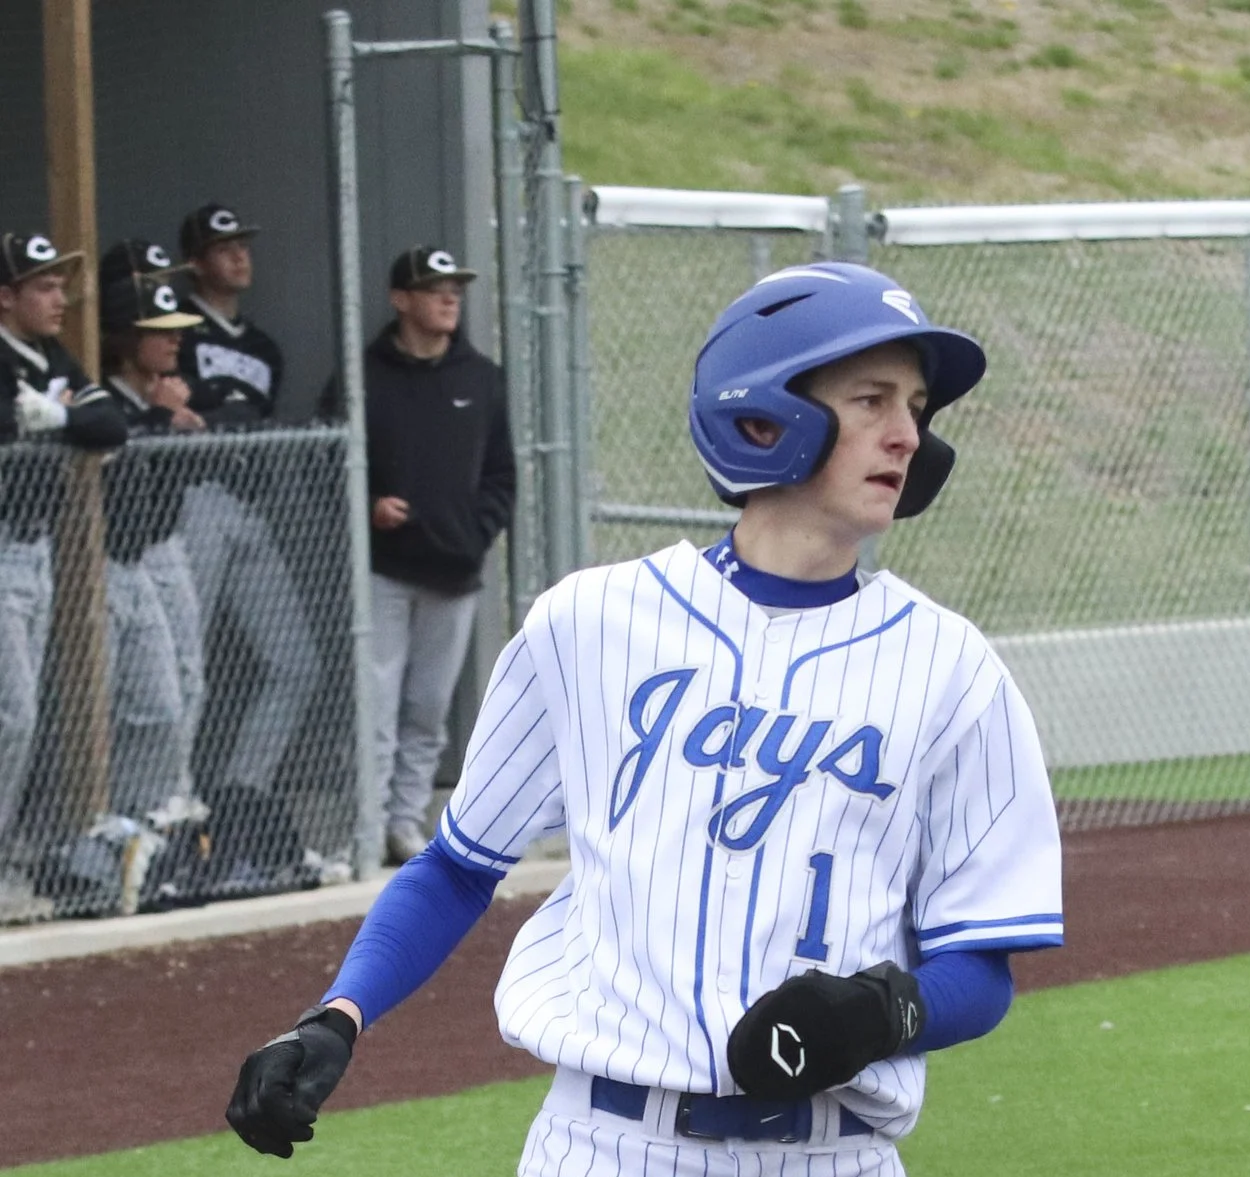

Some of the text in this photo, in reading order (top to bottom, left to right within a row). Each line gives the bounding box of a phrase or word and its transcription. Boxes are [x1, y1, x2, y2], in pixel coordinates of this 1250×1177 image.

[209, 209, 239, 231] C
[26, 236, 57, 260] C
[146, 245, 171, 267] C
[427, 250, 456, 273] C
[154, 285, 177, 312] C
[608, 666, 897, 851] Jays
[794, 851, 835, 963] 1
